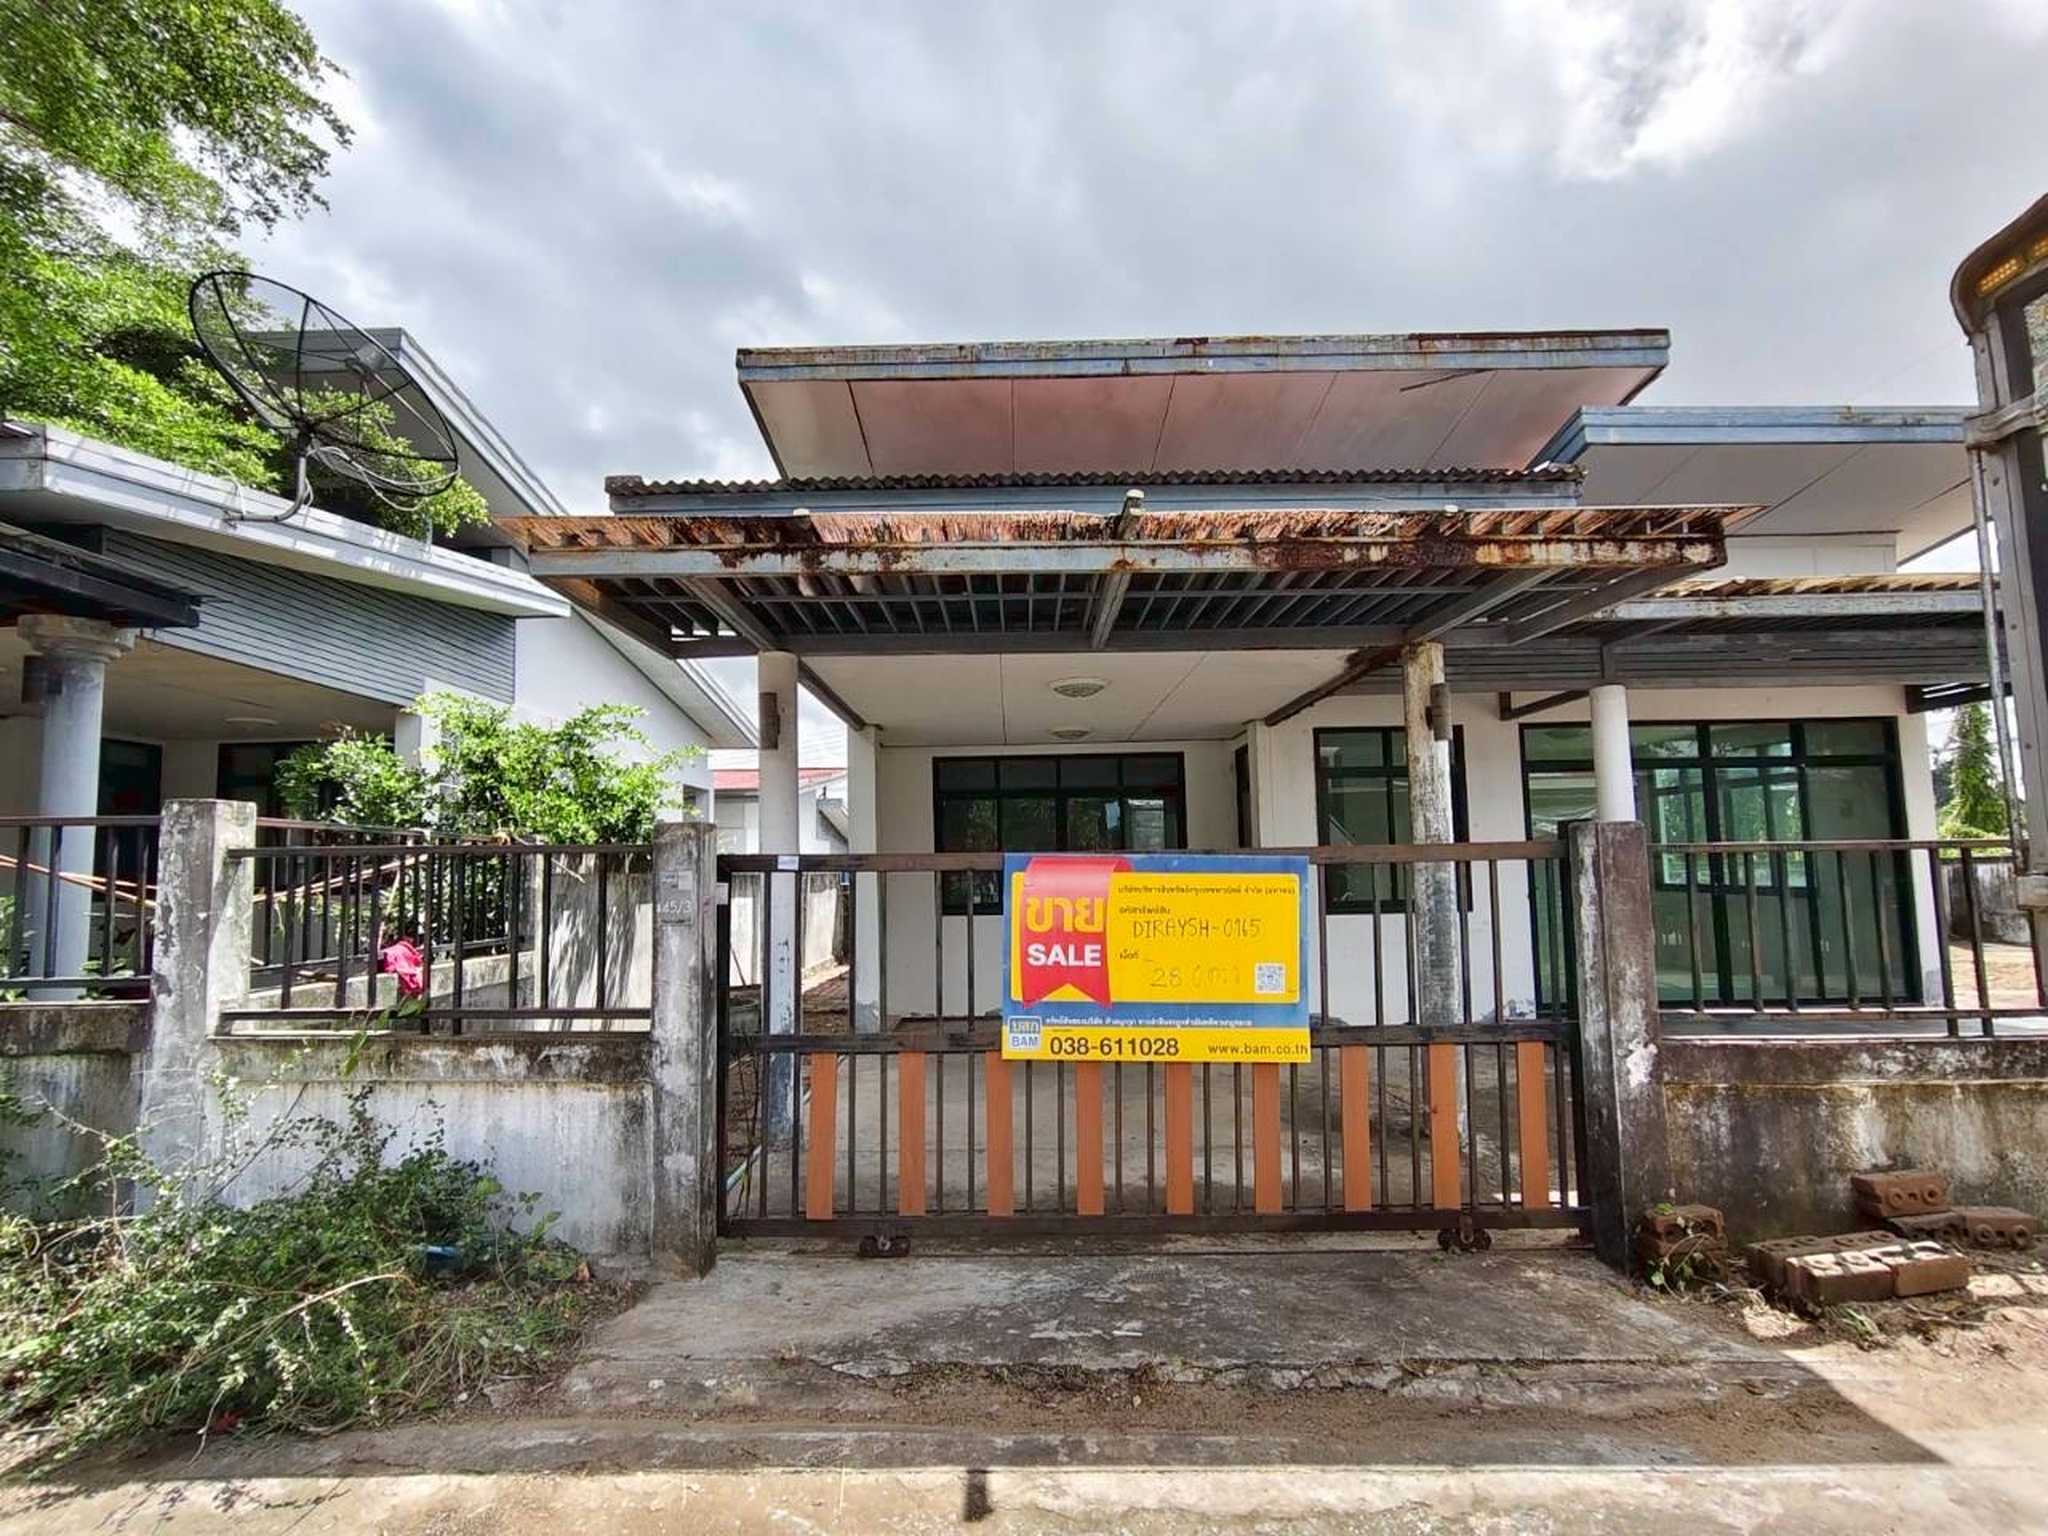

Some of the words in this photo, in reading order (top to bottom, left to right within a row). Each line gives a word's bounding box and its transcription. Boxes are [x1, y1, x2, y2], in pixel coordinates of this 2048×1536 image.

[1026, 896, 1104, 933] ขาย
[1027, 943, 1102, 967] SALE
[1012, 1036, 1038, 1047] BAM
[1050, 1037, 1179, 1056] 038-611028
[1208, 1043, 1308, 1055] www.bam.co.th
